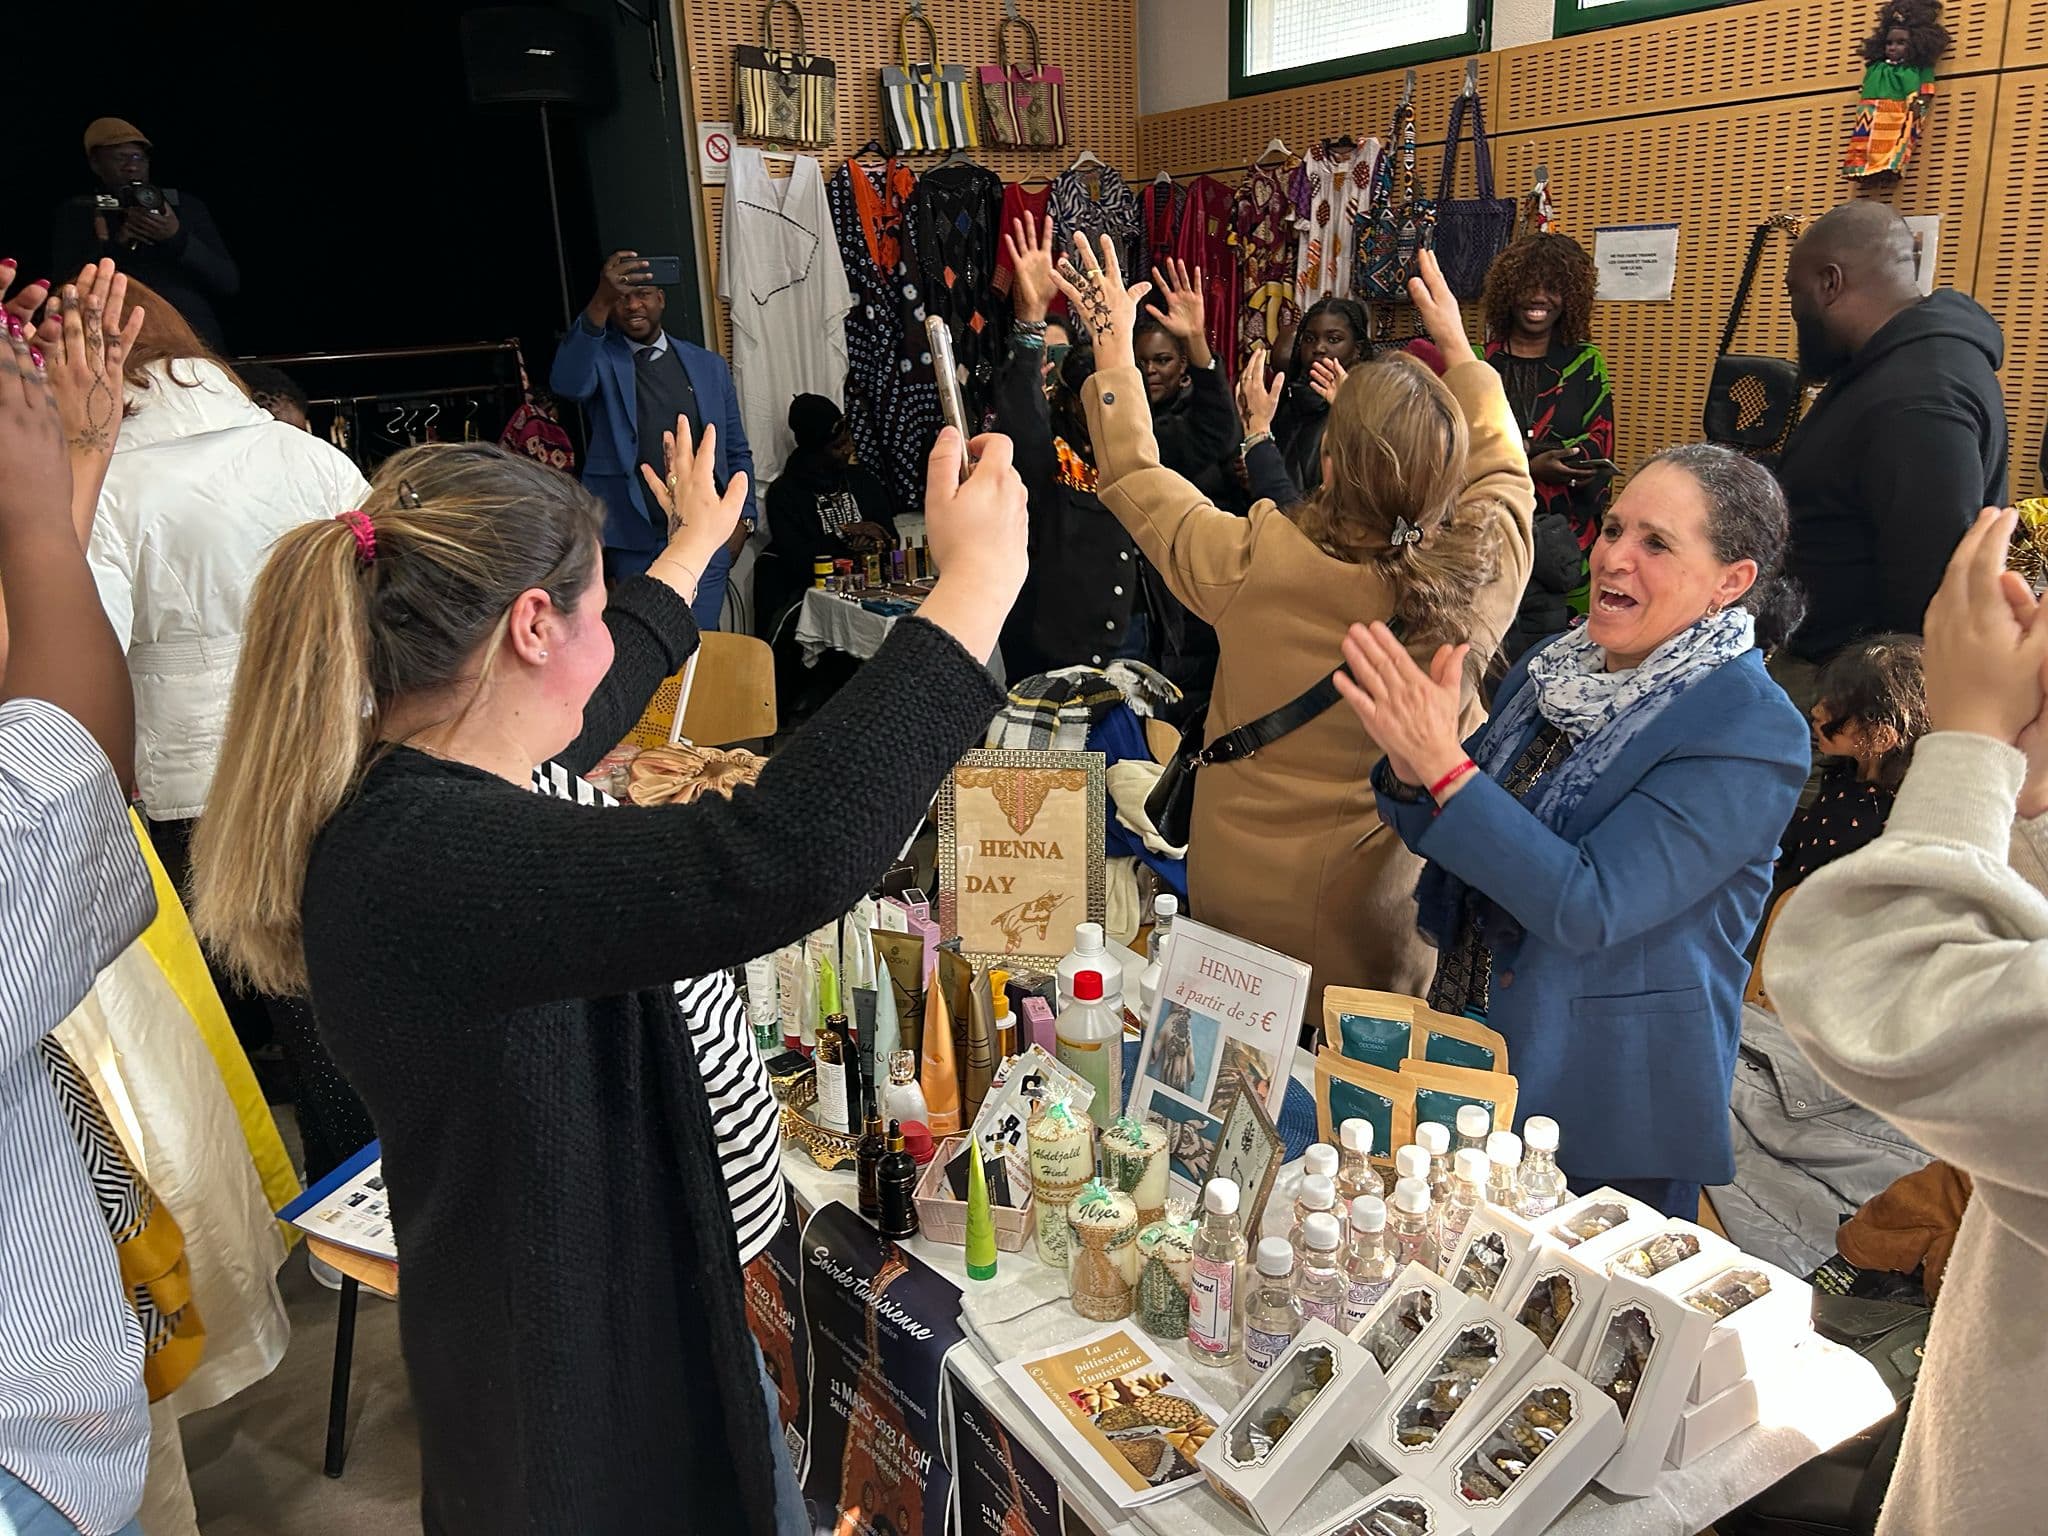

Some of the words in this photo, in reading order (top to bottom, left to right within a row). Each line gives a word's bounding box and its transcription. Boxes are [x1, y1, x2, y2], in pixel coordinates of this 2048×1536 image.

[979, 839, 1064, 860] HENNA
[965, 875, 1016, 894] DAY
[1198, 956, 1263, 996] HENNE
[1175, 981, 1185, 996] à
[1183, 989, 1225, 1012] partir
[1226, 1001, 1245, 1020] de
[1032, 1146, 1081, 1163] Abdeljalil
[1040, 1165, 1069, 1177] Hind
[1079, 1204, 1120, 1223] Ilyes
[809, 1246, 856, 1289] Soirée
[853, 1277, 935, 1341] tunisienne
[1074, 1346, 1131, 1375] pâtisserie
[1083, 1345, 1102, 1357] La
[1077, 1355, 1143, 1385] Tunisienne
[829, 1396, 848, 1419] SALLE
[830, 1378, 841, 1396] 11
[841, 1382, 873, 1421] MARS
[874, 1414, 897, 1447] 2023
[897, 1433, 907, 1454] A
[908, 1446, 932, 1475] 19H
